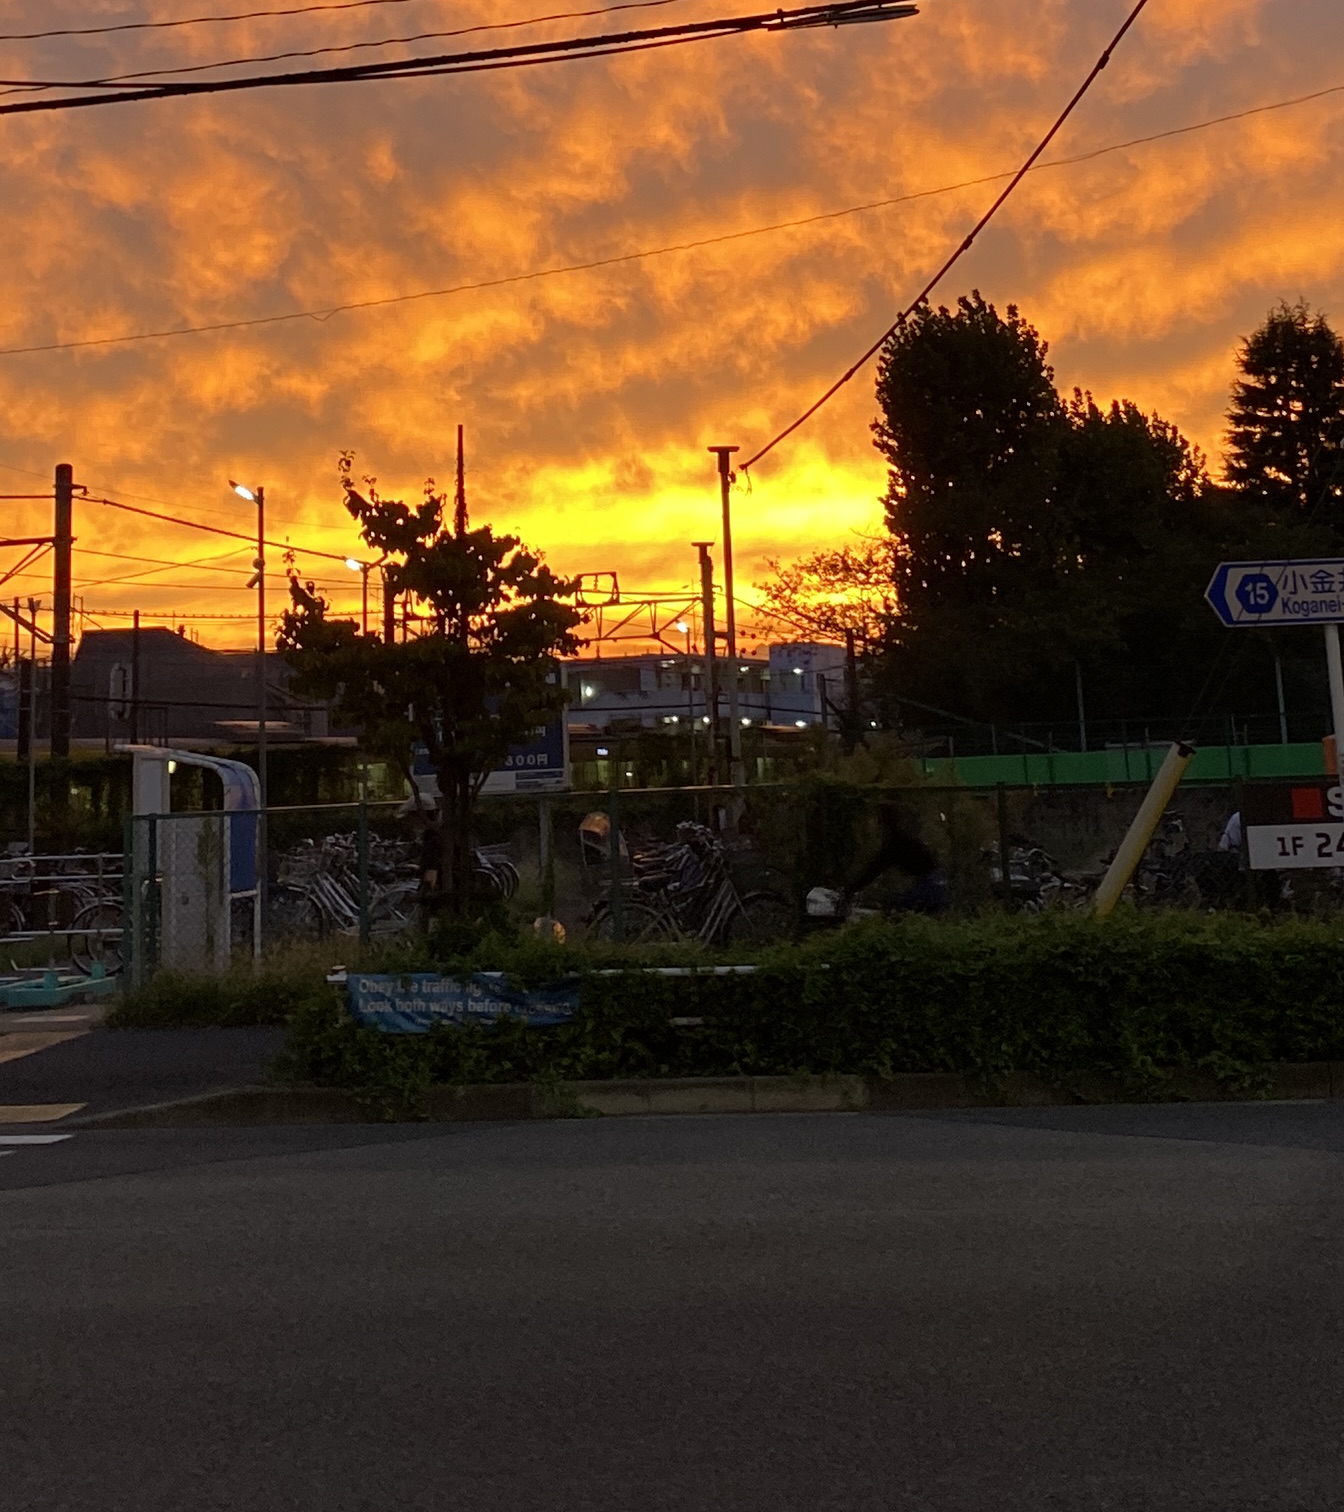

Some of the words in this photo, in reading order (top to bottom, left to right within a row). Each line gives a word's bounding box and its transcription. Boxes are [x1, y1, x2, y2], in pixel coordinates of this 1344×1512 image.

[1245, 582, 1270, 605] 15
[1277, 835, 1304, 857] 1F
[358, 979, 394, 996] Obey
[397, 978, 419, 993] te
[422, 978, 461, 993] traffic
[358, 998, 393, 1014] Look
[396, 996, 426, 1012] both
[429, 999, 464, 1017] ways
[467, 997, 512, 1013] before
